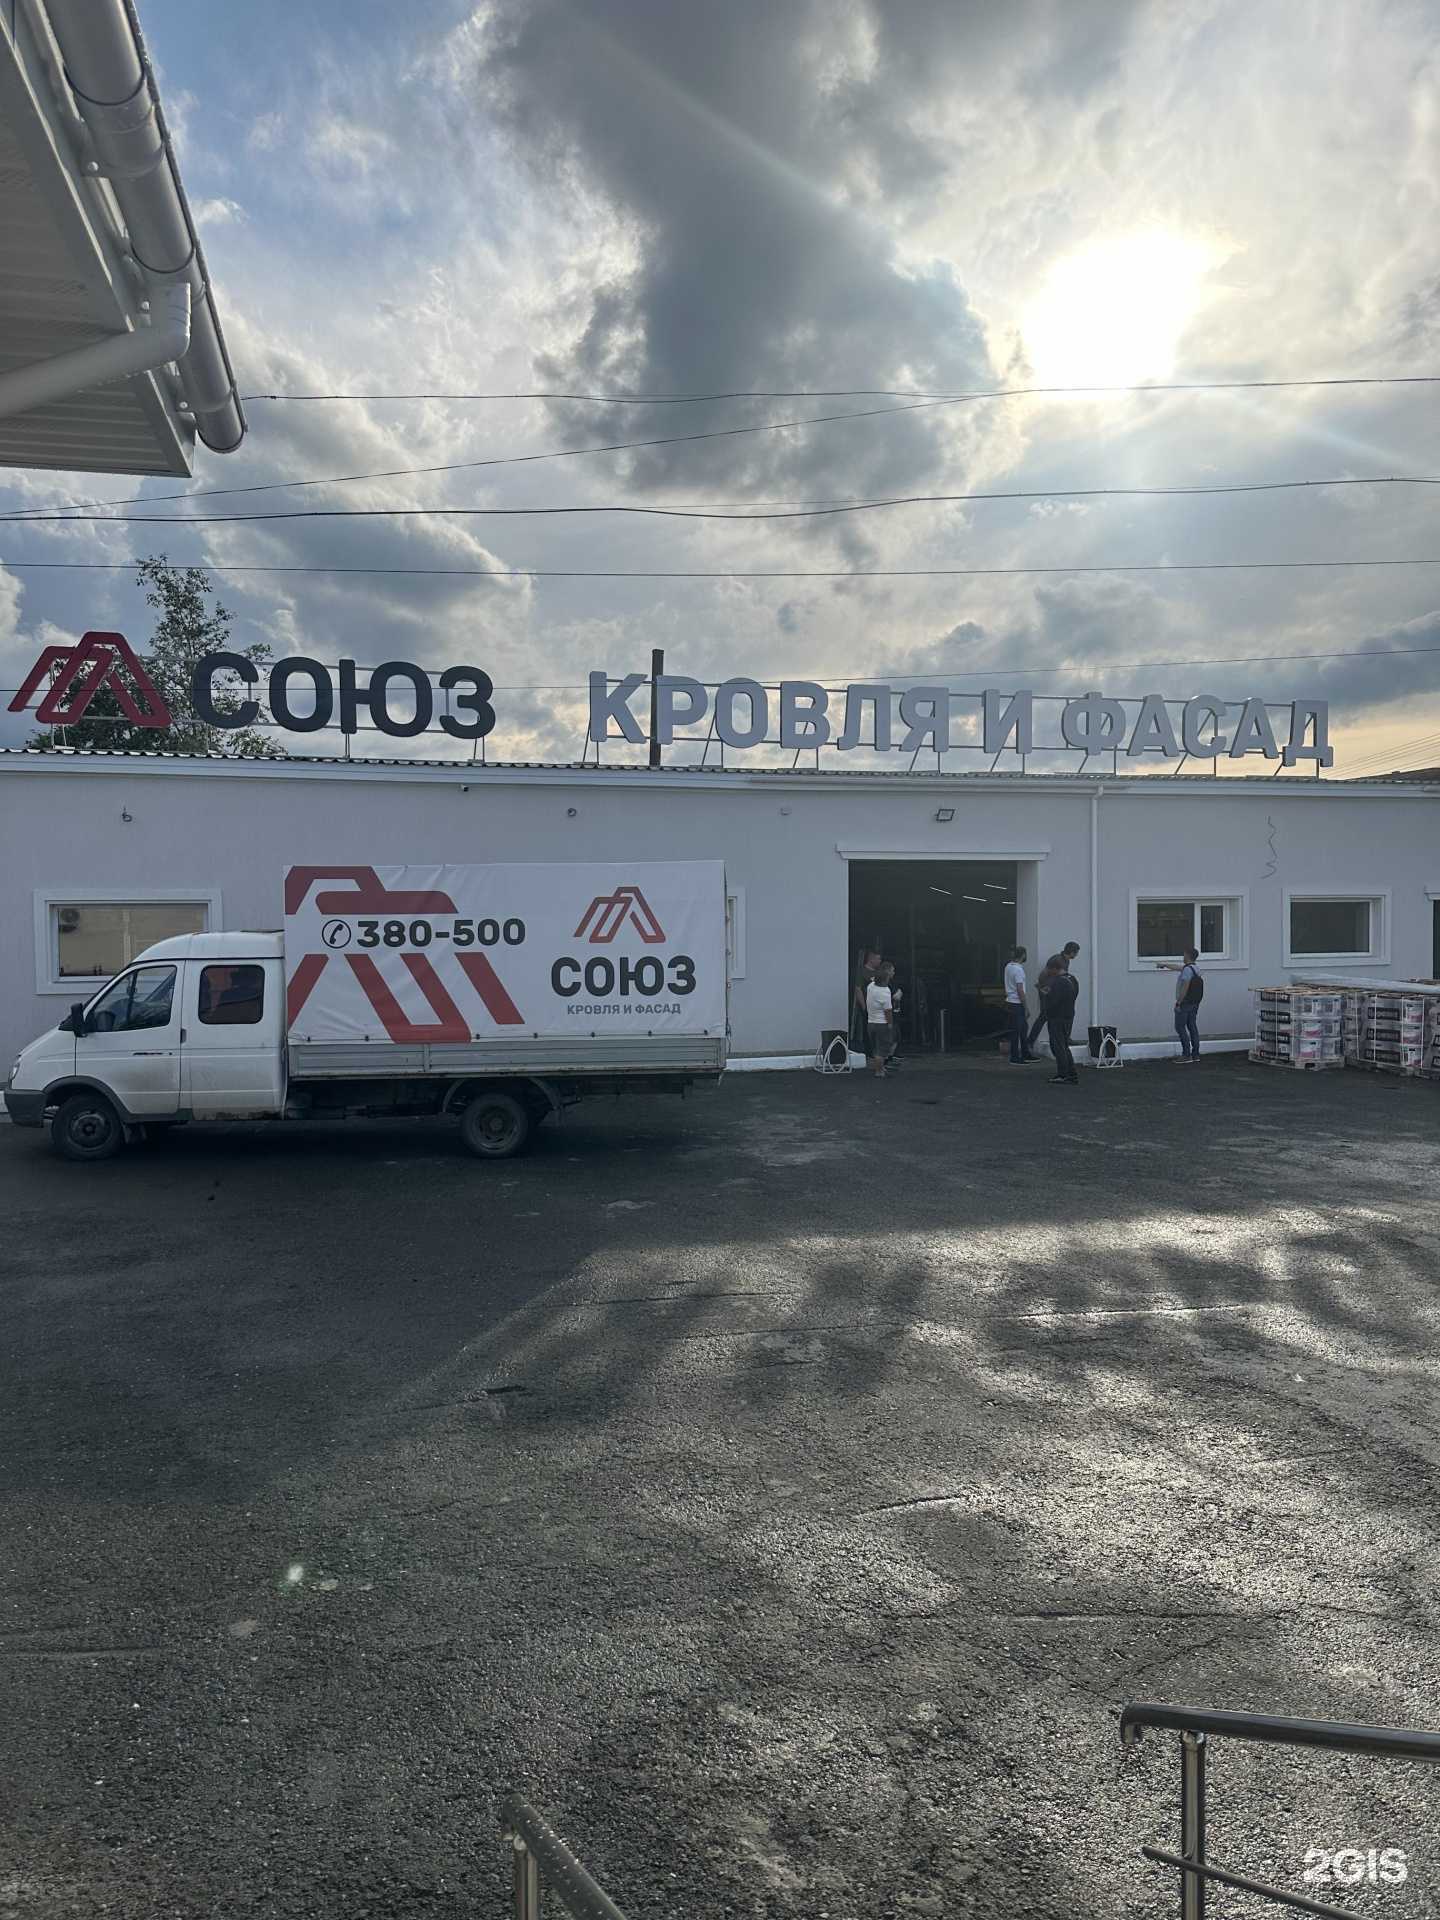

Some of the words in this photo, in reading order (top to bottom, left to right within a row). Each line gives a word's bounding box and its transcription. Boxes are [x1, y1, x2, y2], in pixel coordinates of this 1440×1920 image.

[193, 652, 496, 739] СОЮЗ
[589, 670, 950, 753] КРОВЛЯ
[982, 689, 1033, 754] И
[1061, 691, 1334, 768] ФАСАД
[356, 918, 526, 948] 380-500
[551, 955, 697, 997] СОЮЗ
[567, 1004, 620, 1015] КРОВЛЯ
[623, 1004, 632, 1014] И
[635, 1003, 681, 1015] ФАСАД
